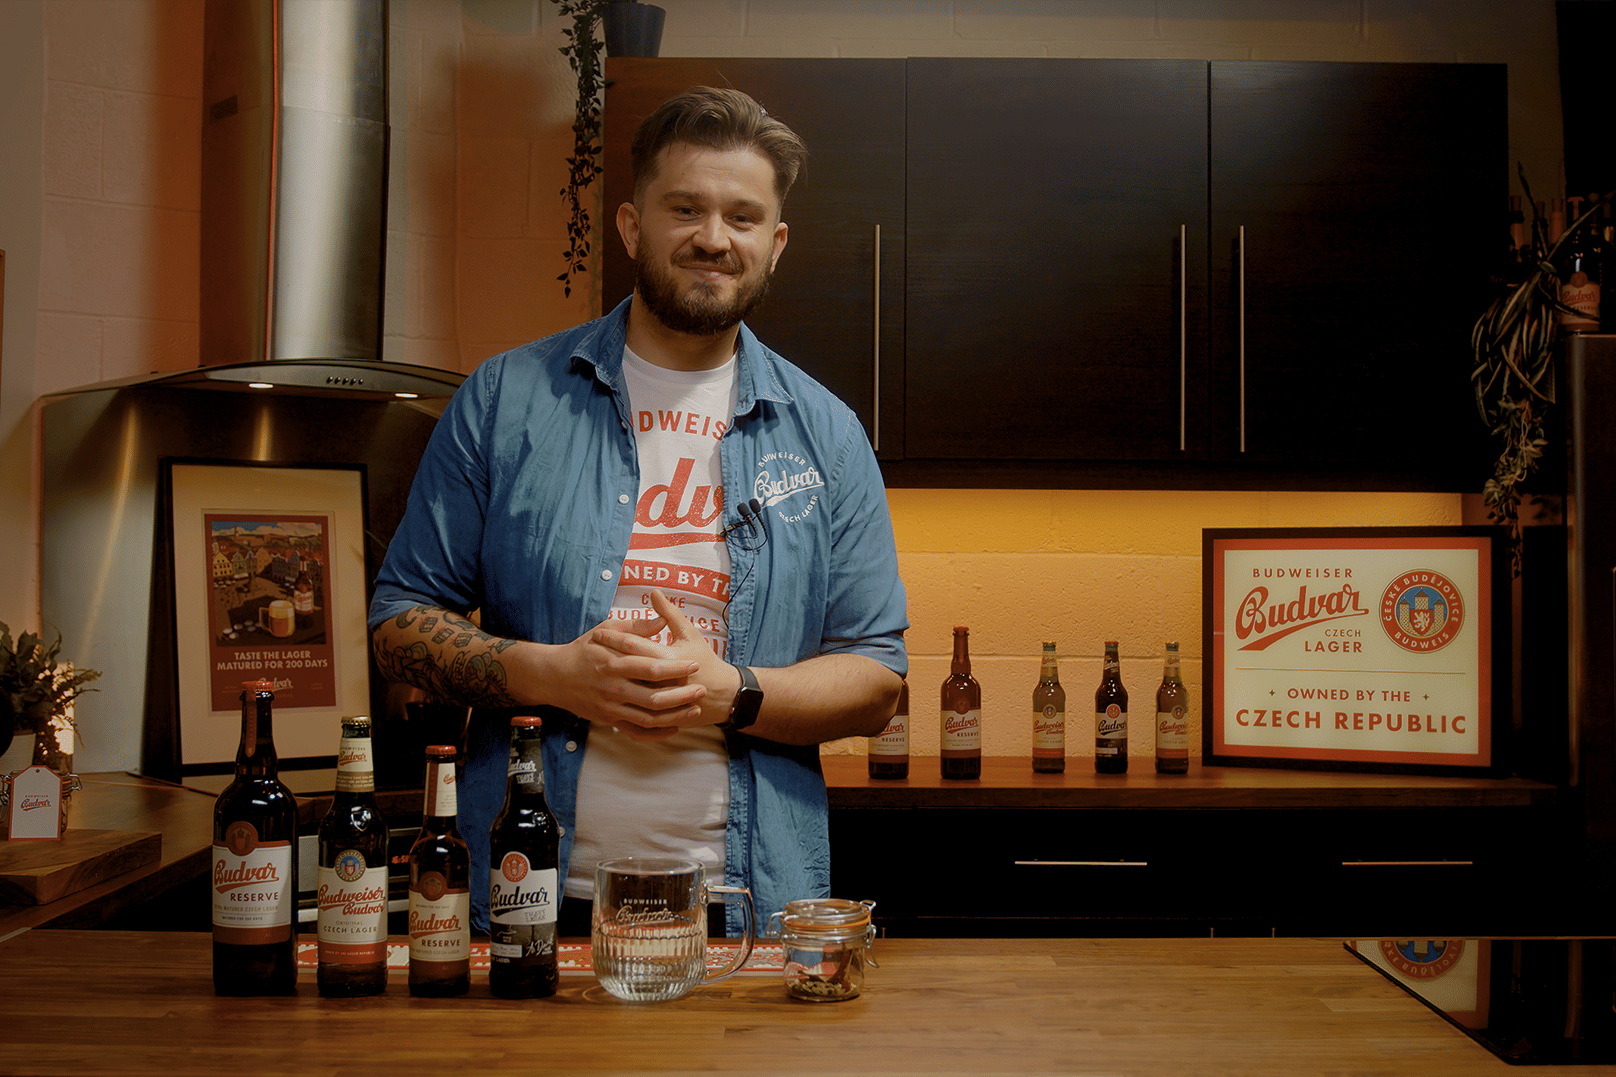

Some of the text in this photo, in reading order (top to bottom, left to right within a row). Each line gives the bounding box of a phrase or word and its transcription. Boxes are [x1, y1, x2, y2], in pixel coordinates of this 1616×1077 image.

[630, 410, 727, 441] DWEIS
[754, 466, 825, 508] Budvar
[801, 495, 818, 518] LAGER
[624, 566, 670, 581] NED
[677, 571, 704, 588] BY
[1252, 568, 1353, 578] BUDWEISER
[1235, 583, 1370, 651] Budvar
[1324, 629, 1361, 637] CZECH
[1394, 631, 1449, 649] BUDWEIS
[234, 650, 311, 661] TASTE THE LAGER
[1304, 641, 1362, 653] LAGER
[217, 659, 328, 671] MATURED FOR 200 DAYS
[1287, 688, 1411, 702] OWNED BY THE
[945, 716, 979, 734] Budvar
[1236, 709, 1467, 734] CZECH REPUBLIC
[508, 759, 537, 777] udvar
[214, 859, 279, 894] Budvar
[230, 892, 279, 901] RESERVE
[319, 884, 386, 905] Budweiser
[491, 884, 550, 917] Budvar
[343, 901, 384, 916] Budvar
[410, 911, 461, 940] Budvar
